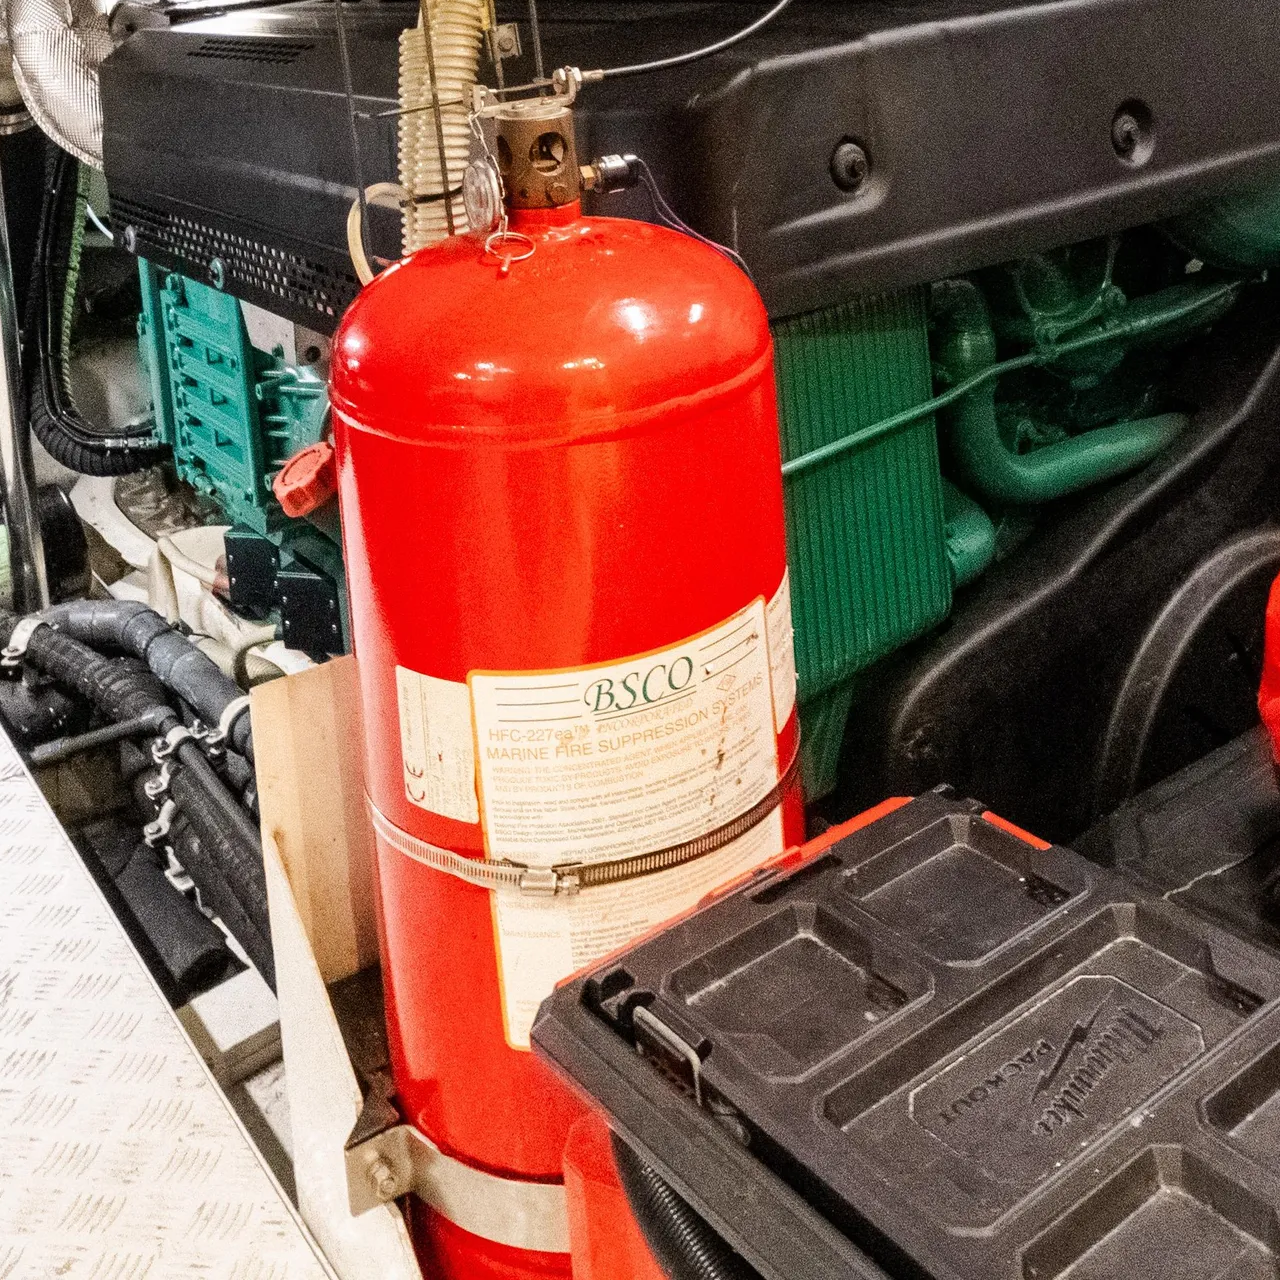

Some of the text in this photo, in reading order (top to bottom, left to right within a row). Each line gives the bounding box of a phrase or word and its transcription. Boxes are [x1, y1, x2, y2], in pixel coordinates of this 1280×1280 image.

[486, 746, 549, 760] MARINE
[555, 742, 593, 758] FIRE
[598, 708, 709, 754] SUPPRESSION
[712, 673, 764, 718] SYSTEMS
[584, 656, 694, 712] BSCO
[941, 1038, 1057, 1125] PACKOUT
